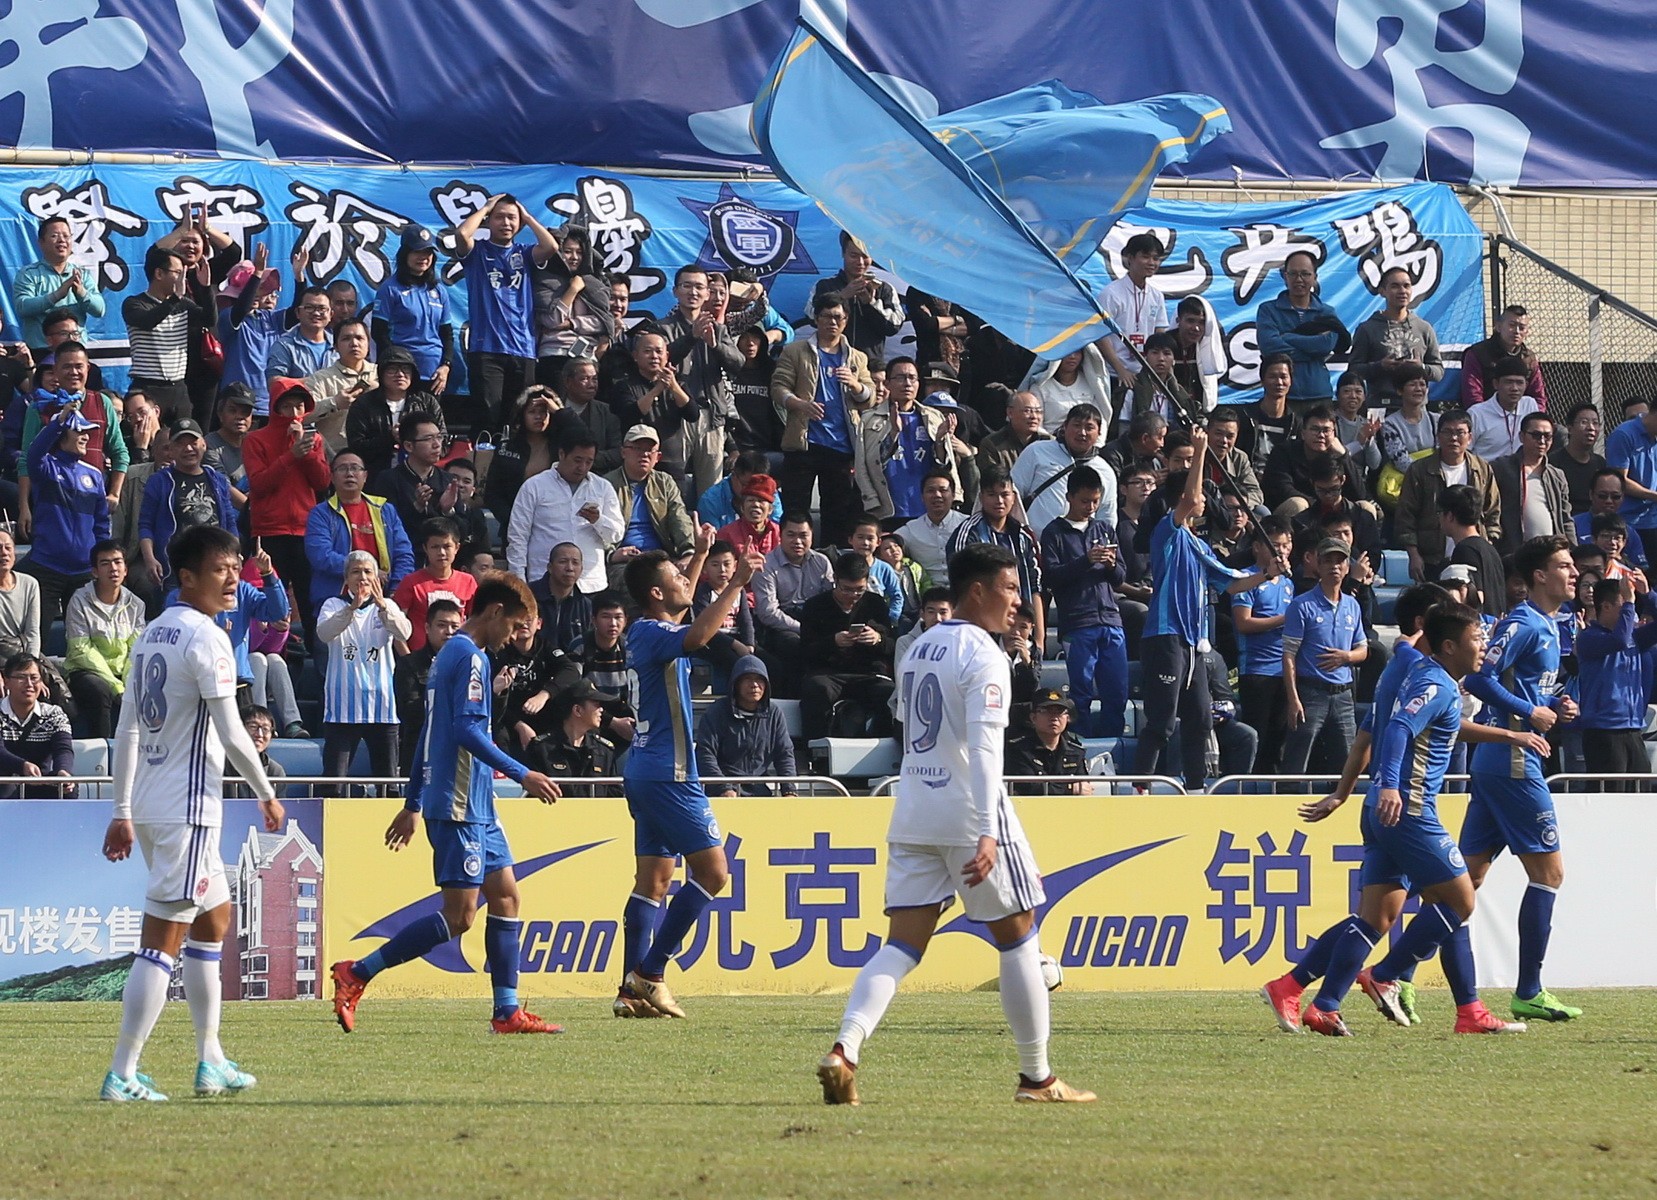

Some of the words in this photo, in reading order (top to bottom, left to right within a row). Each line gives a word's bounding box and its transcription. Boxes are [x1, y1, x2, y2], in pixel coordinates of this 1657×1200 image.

[487, 268, 523, 290] 富力
[342, 643, 380, 662] 富力
[133, 652, 168, 733] 18
[902, 671, 943, 754] 19
[484, 920, 618, 973] CAN
[1060, 915, 1189, 967] UCAN
